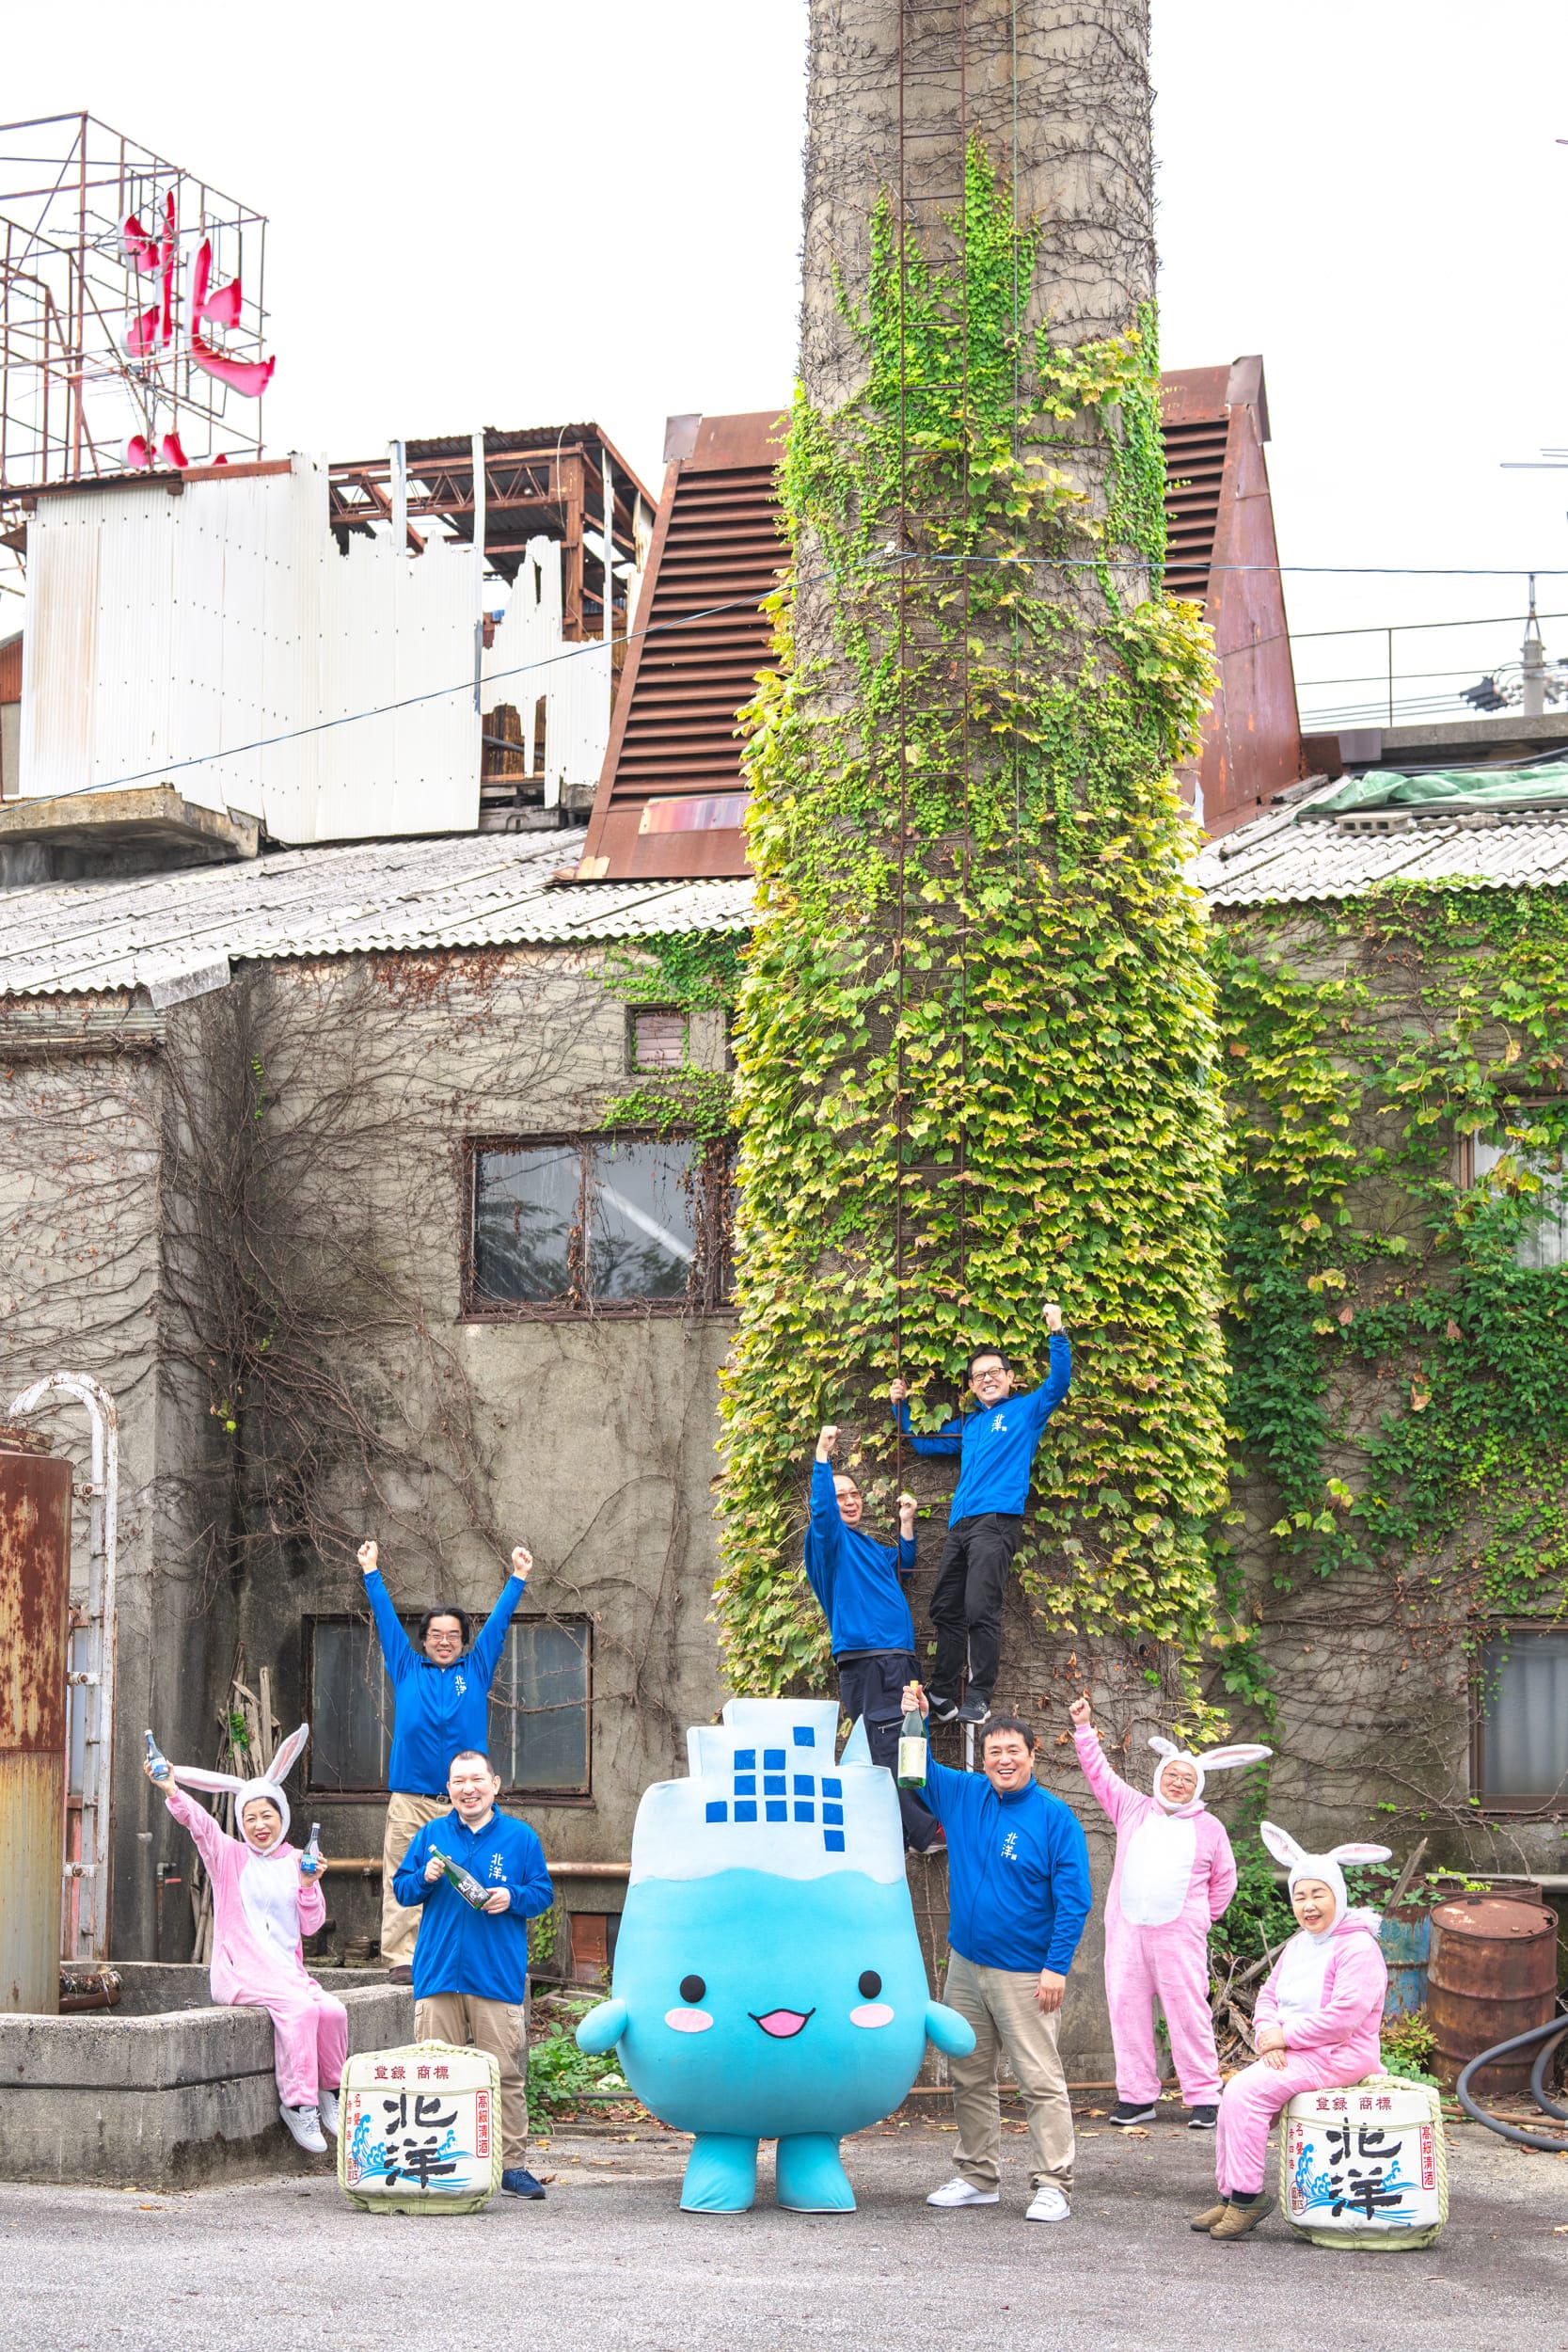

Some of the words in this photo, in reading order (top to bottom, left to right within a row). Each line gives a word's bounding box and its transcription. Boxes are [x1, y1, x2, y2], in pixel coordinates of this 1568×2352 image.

[119, 187, 277, 469] 北
[454, 1675, 467, 1697] 北洋
[488, 1852, 504, 1880] 北洋
[1000, 1832, 1019, 1859] 北洋
[383, 2088, 458, 2189] 北洋
[478, 2094, 488, 2153] 高級清酒
[1325, 2117, 1402, 2221] 北洋
[1421, 2125, 1434, 2185] 高級清酒
